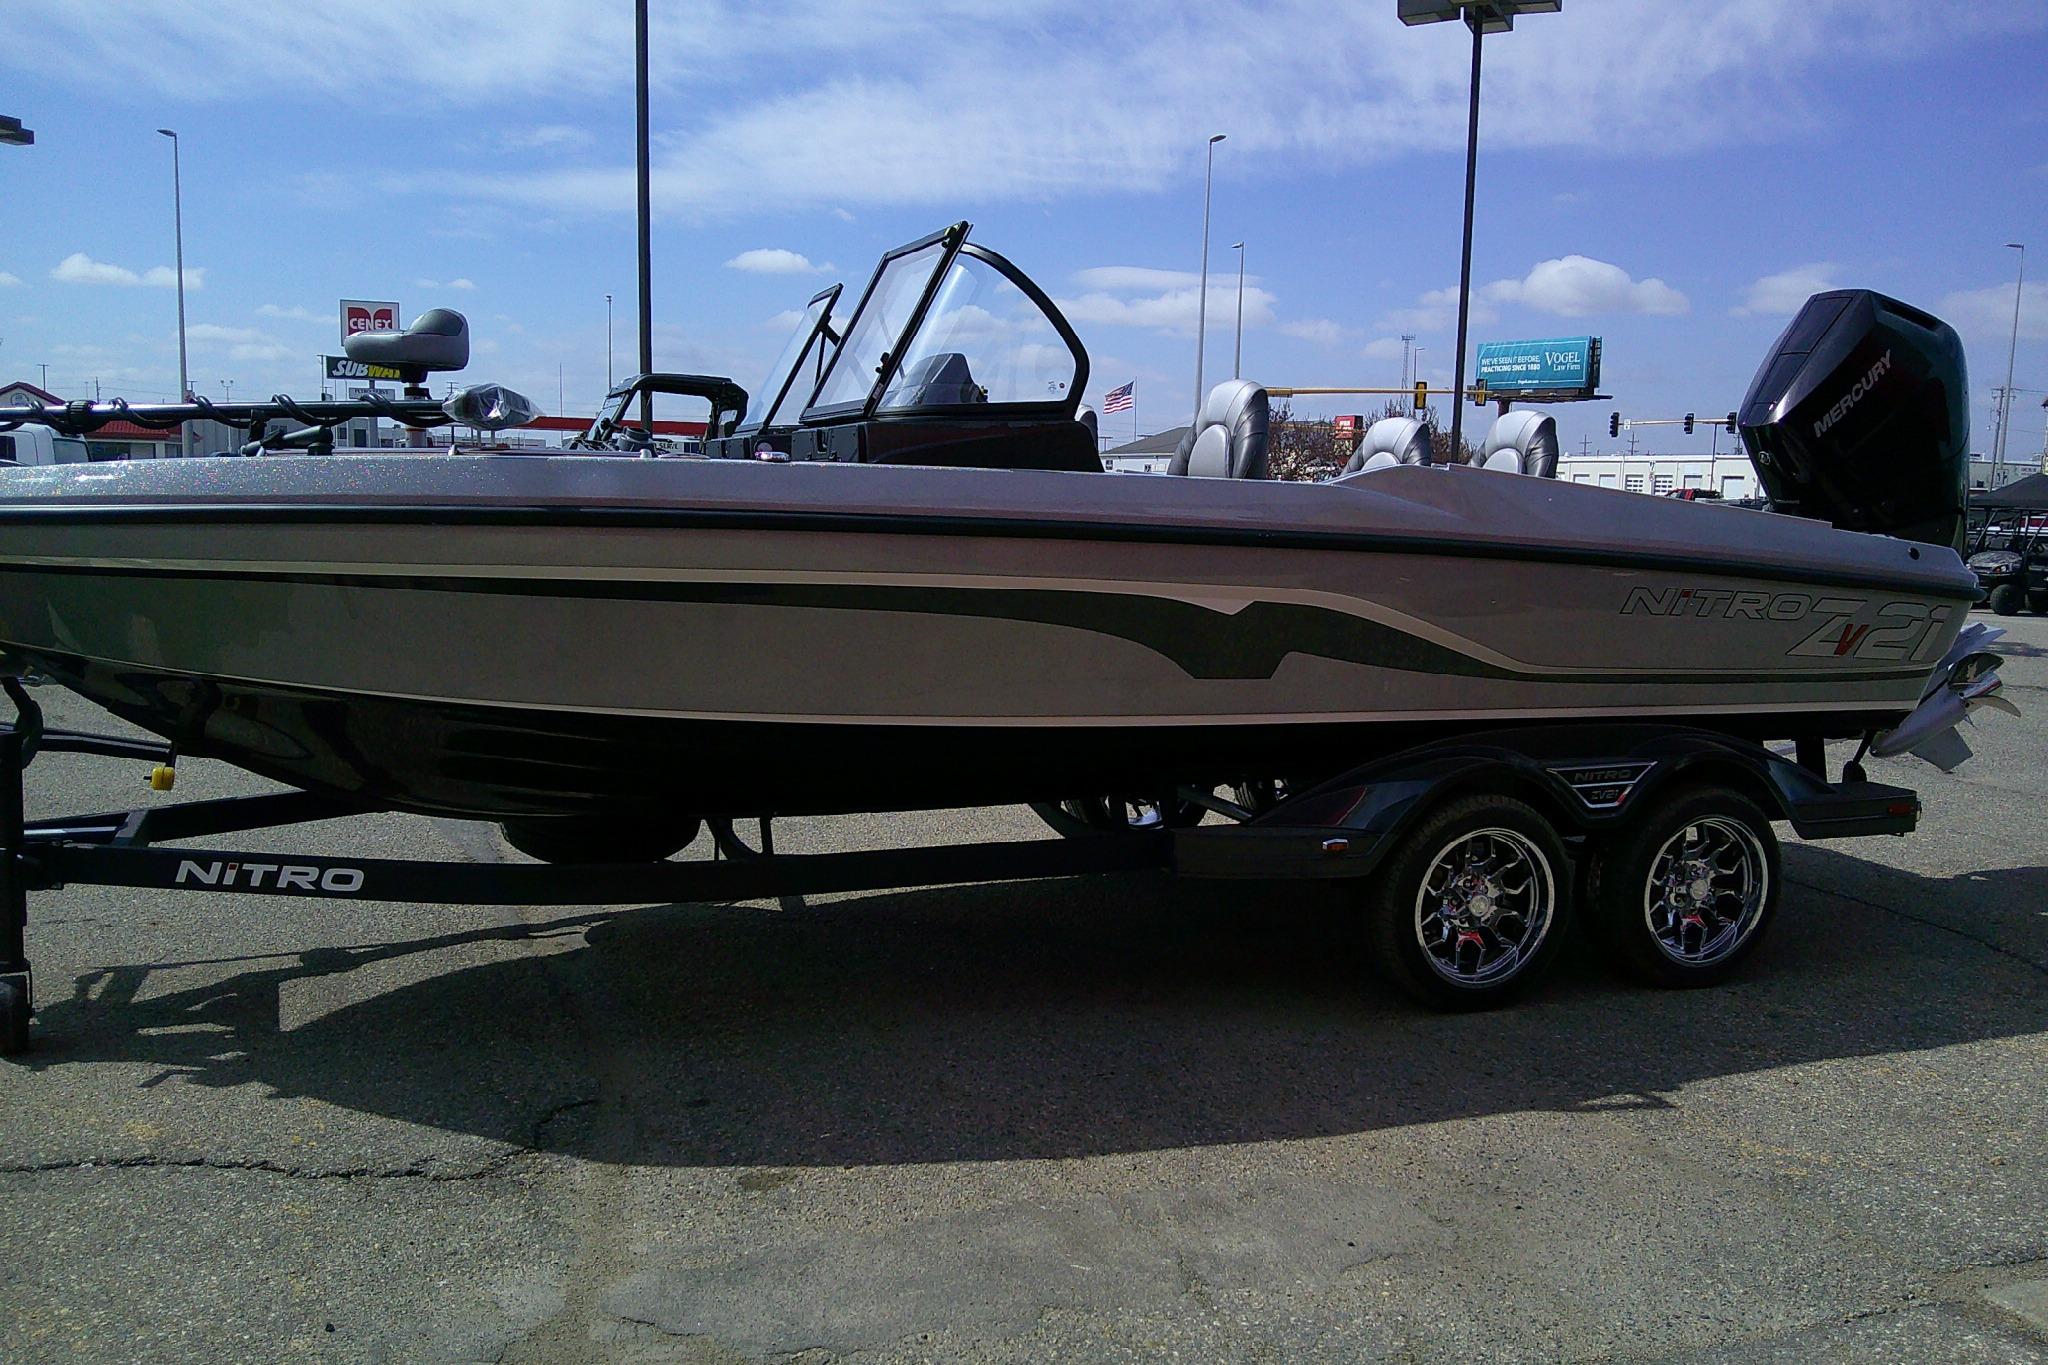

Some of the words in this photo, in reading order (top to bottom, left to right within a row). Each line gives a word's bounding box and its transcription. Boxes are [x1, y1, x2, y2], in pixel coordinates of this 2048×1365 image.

[349, 318, 392, 331] CENEX
[1498, 356, 1512, 365] SEEN
[1545, 352, 1580, 366] VOGEL
[1481, 365, 1511, 373] PRACTICING
[1511, 364, 1526, 372] SINCE
[1566, 363, 1580, 371] Firm
[1813, 349, 1892, 438] MERCURY
[1620, 586, 1812, 621] NITRO
[1574, 769, 1632, 782] NITRO
[175, 860, 365, 892] NITRO
